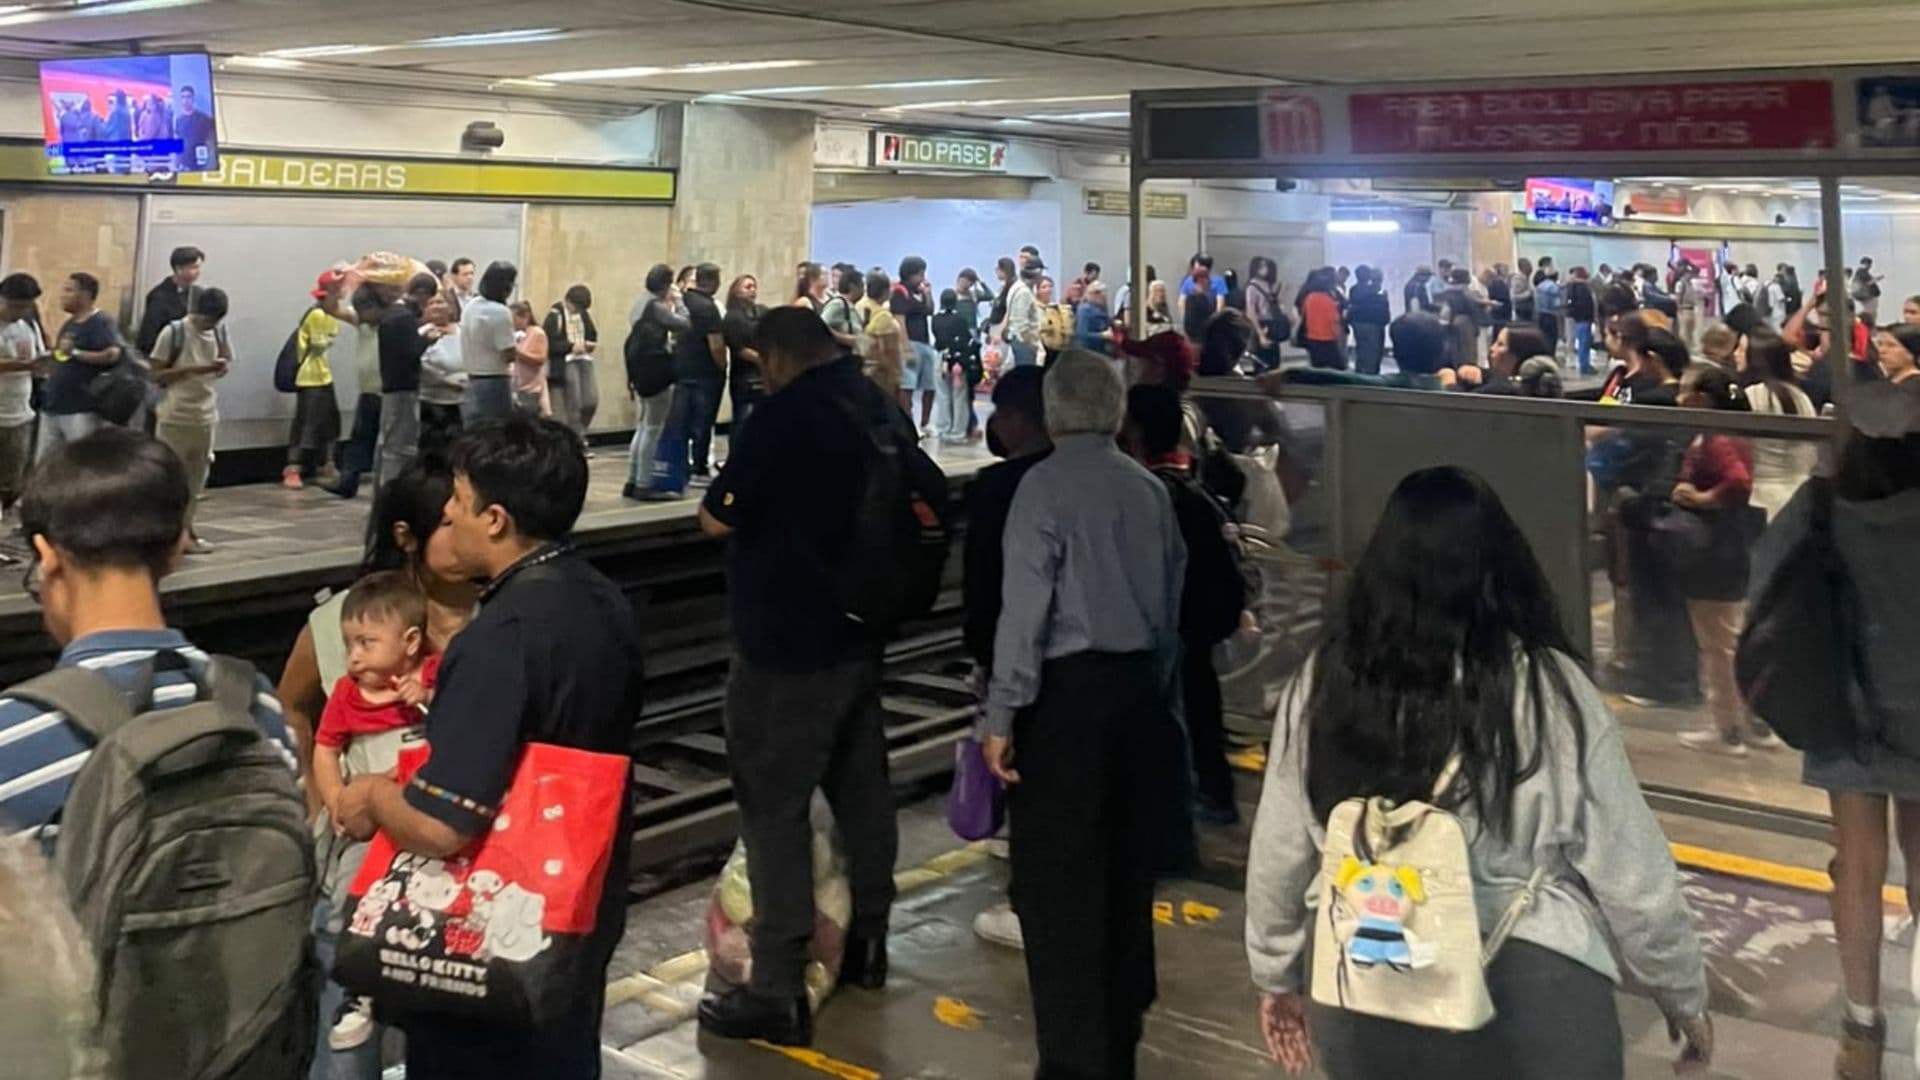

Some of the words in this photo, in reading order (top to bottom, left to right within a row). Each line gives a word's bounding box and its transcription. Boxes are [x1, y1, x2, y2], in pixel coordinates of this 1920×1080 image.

[1482, 89, 1674, 116] EXCLUSIVA
[1682, 86, 1789, 111] PARA
[1415, 123, 1583, 147] MUJERES
[1640, 115, 1750, 145] NIÑOS
[904, 139, 933, 161] NO
[935, 142, 987, 164] PASE
[379, 948, 431, 971] HELLO
[432, 959, 488, 982] KITTY
[381, 965, 417, 983] AND
[420, 972, 487, 998] FRIENDS
